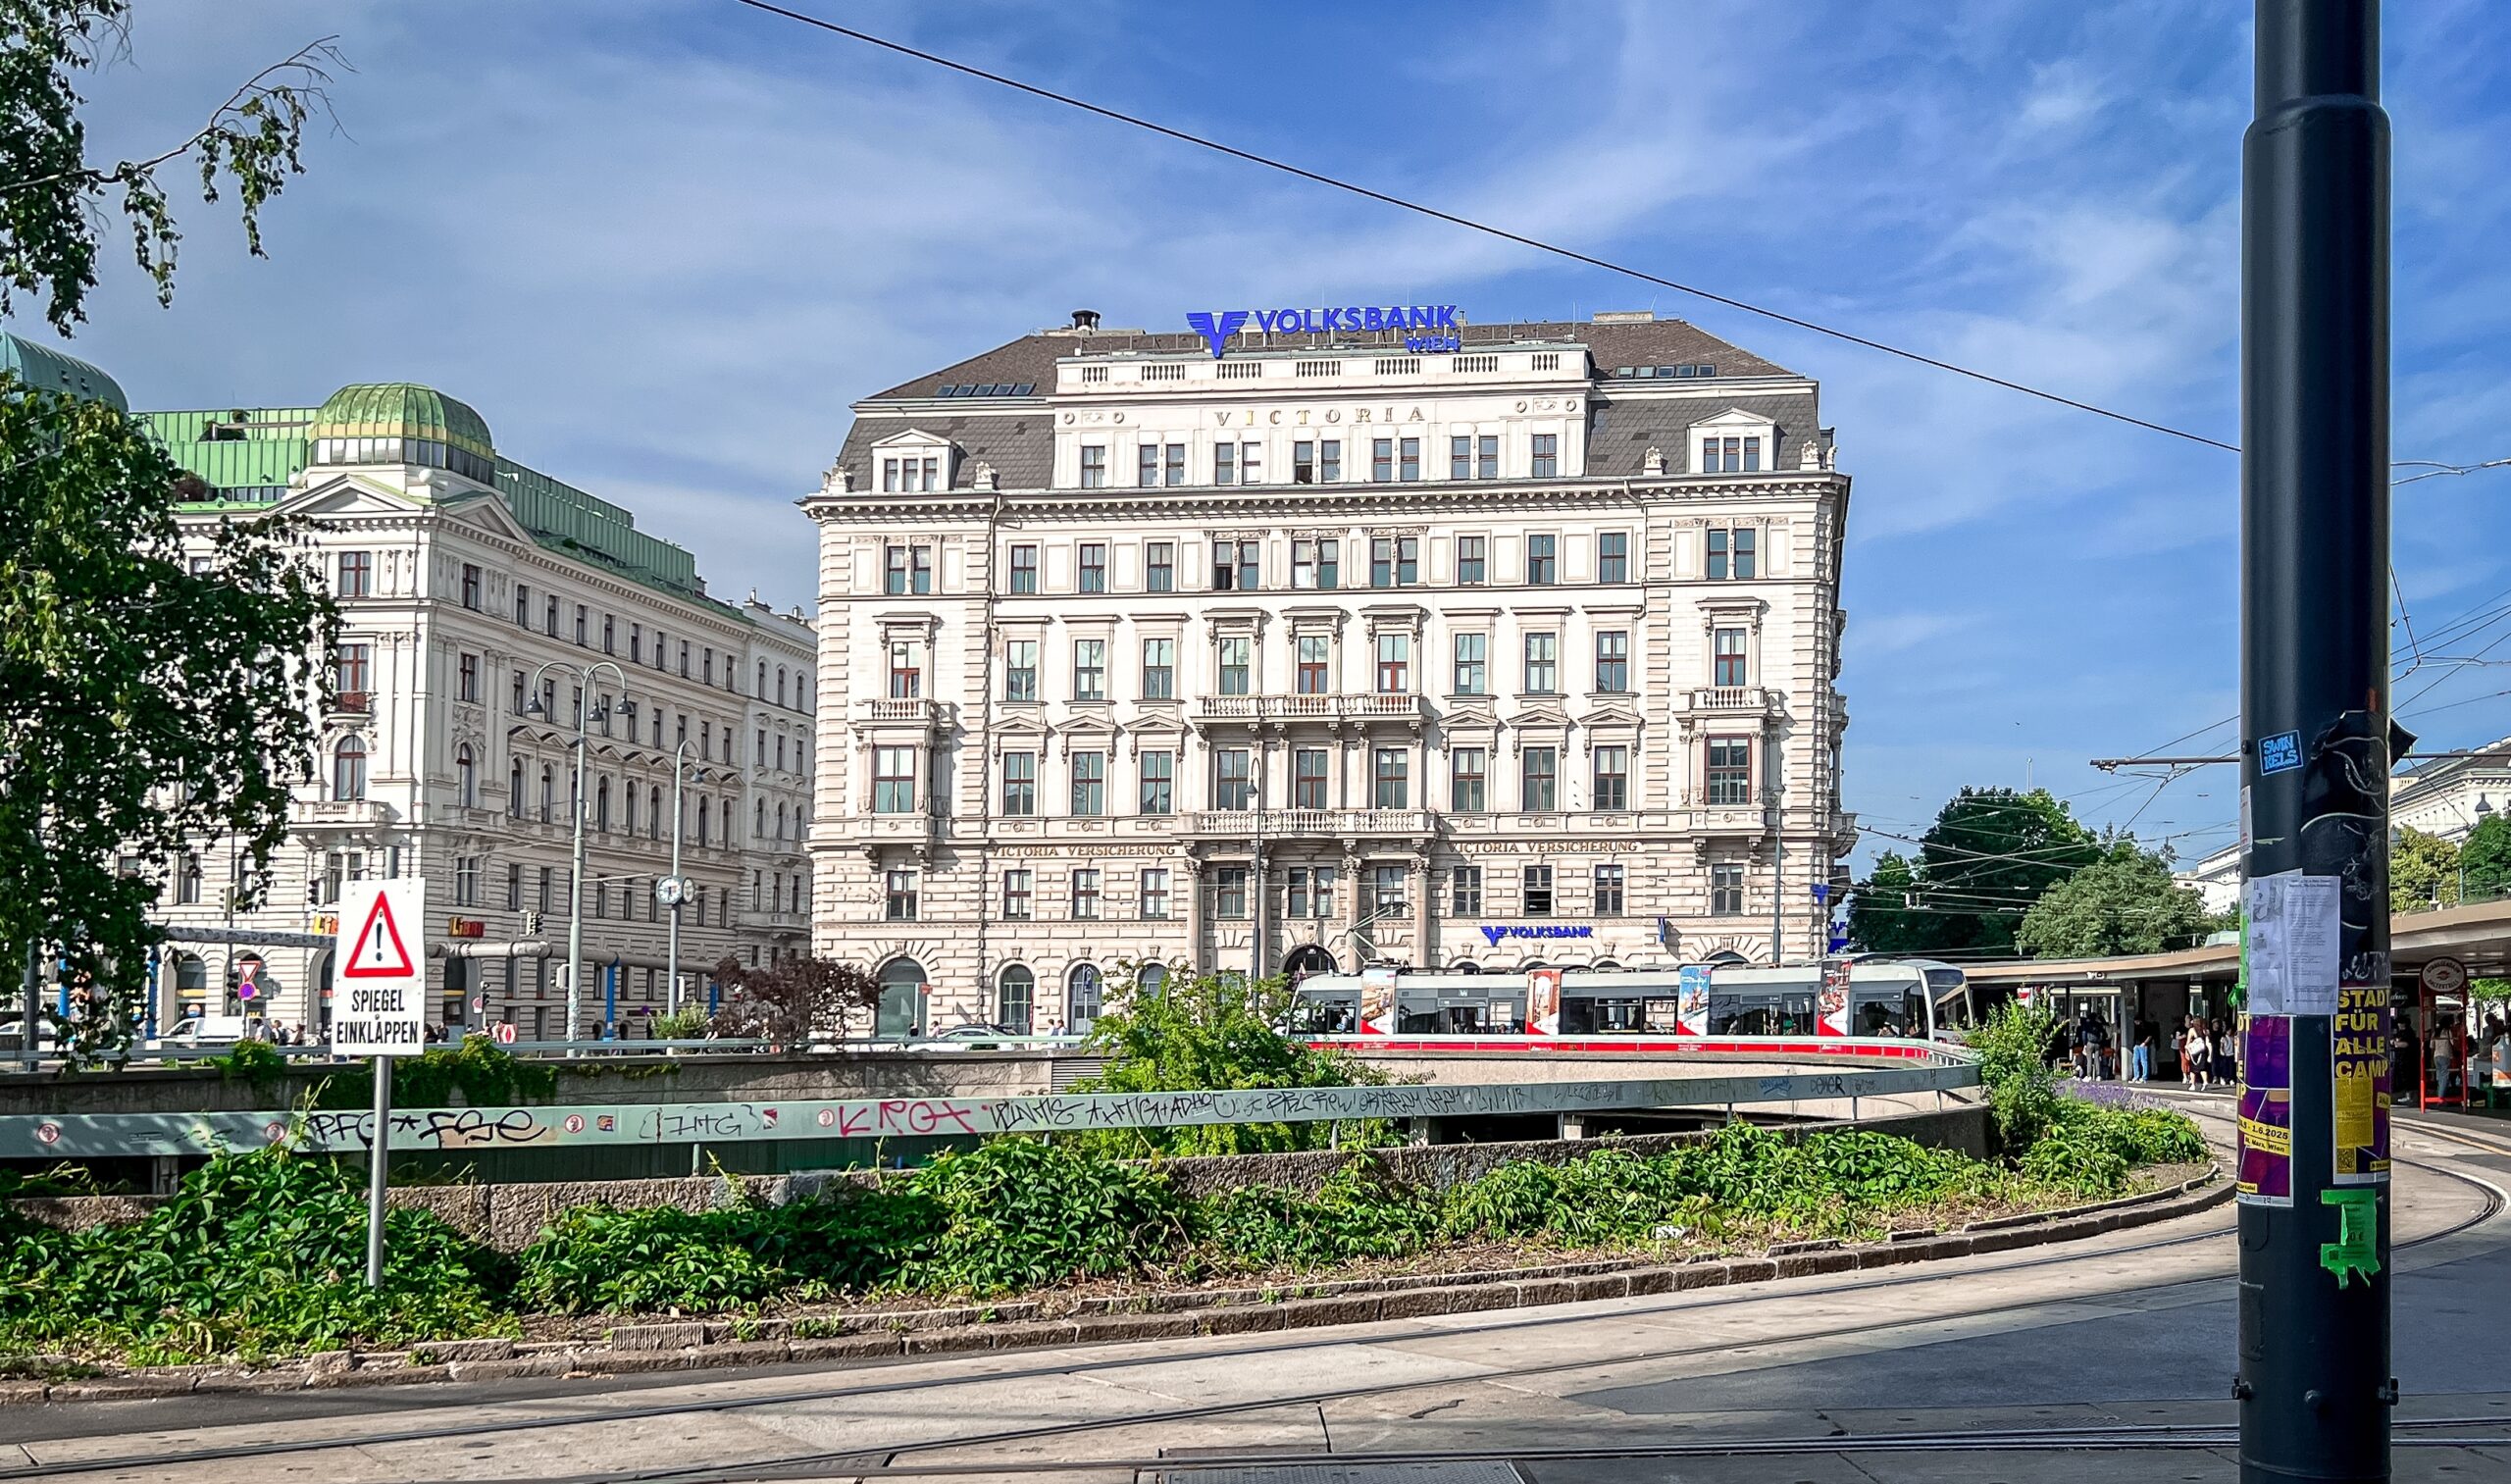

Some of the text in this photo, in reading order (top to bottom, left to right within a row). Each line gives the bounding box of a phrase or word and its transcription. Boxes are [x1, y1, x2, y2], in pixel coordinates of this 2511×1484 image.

[1255, 305, 1457, 334] VOLKSBANK
[1405, 335, 1460, 352] WIEN
[1214, 407, 1425, 427] VICTORIA
[991, 844, 1176, 857] VICTORIA VERSICHERUNG
[1447, 841, 1638, 853] VICTORIA VERSICHERUNG
[1508, 926, 1593, 939] VOLKSBANK
[351, 989, 405, 1012] SPIEGEL
[2338, 989, 2390, 1008] STADT
[2334, 1008, 2379, 1032] FÜR
[336, 1021, 418, 1044] EINKLAPPEN
[2334, 1036, 2385, 1055] ALLE
[2335, 1059, 2388, 1080] CAMP
[2252, 1124, 2288, 1141] 1.6.2025
